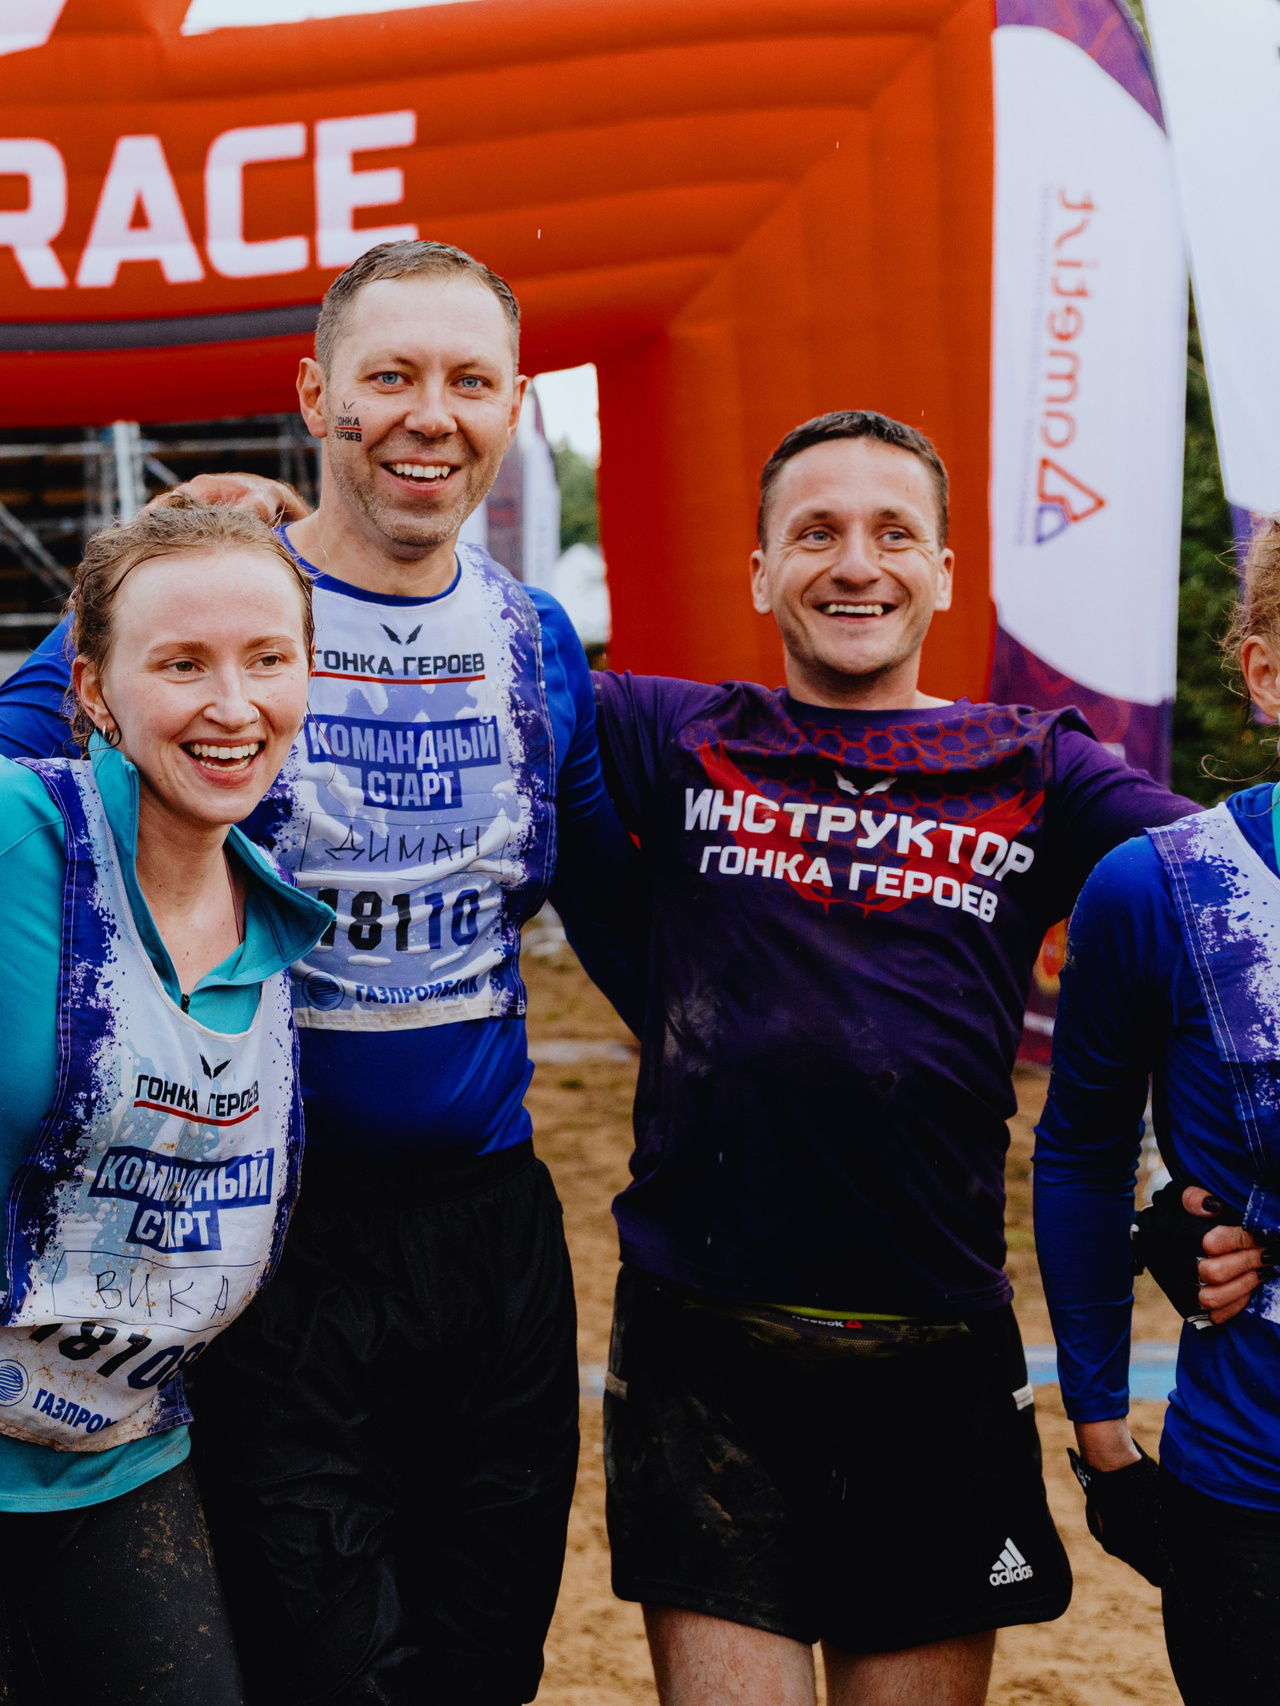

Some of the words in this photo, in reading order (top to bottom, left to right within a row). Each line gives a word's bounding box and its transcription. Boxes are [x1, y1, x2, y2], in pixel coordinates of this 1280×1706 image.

[336, 416, 360, 427] ОНКА
[403, 652, 485, 677] ГЕРОЕВ
[307, 716, 497, 770] КОМАНДНЫЙ
[367, 770, 455, 807] СТАРТ
[324, 824, 481, 866] ДИМАН
[684, 787, 1035, 882] ИНСТРУКТОР
[699, 845, 833, 888] ГОНКА
[848, 862, 999, 923] ГЕРОЕВ
[318, 888, 481, 951] 18110
[355, 974, 478, 1005] ГАЗПРОМБАНК
[136, 1074, 199, 1113] ГОНКА
[206, 1080, 260, 1117] ГЕРОЕВ
[95, 1270, 229, 1320] ВИКА
[989, 1565, 1034, 1587] adidas
